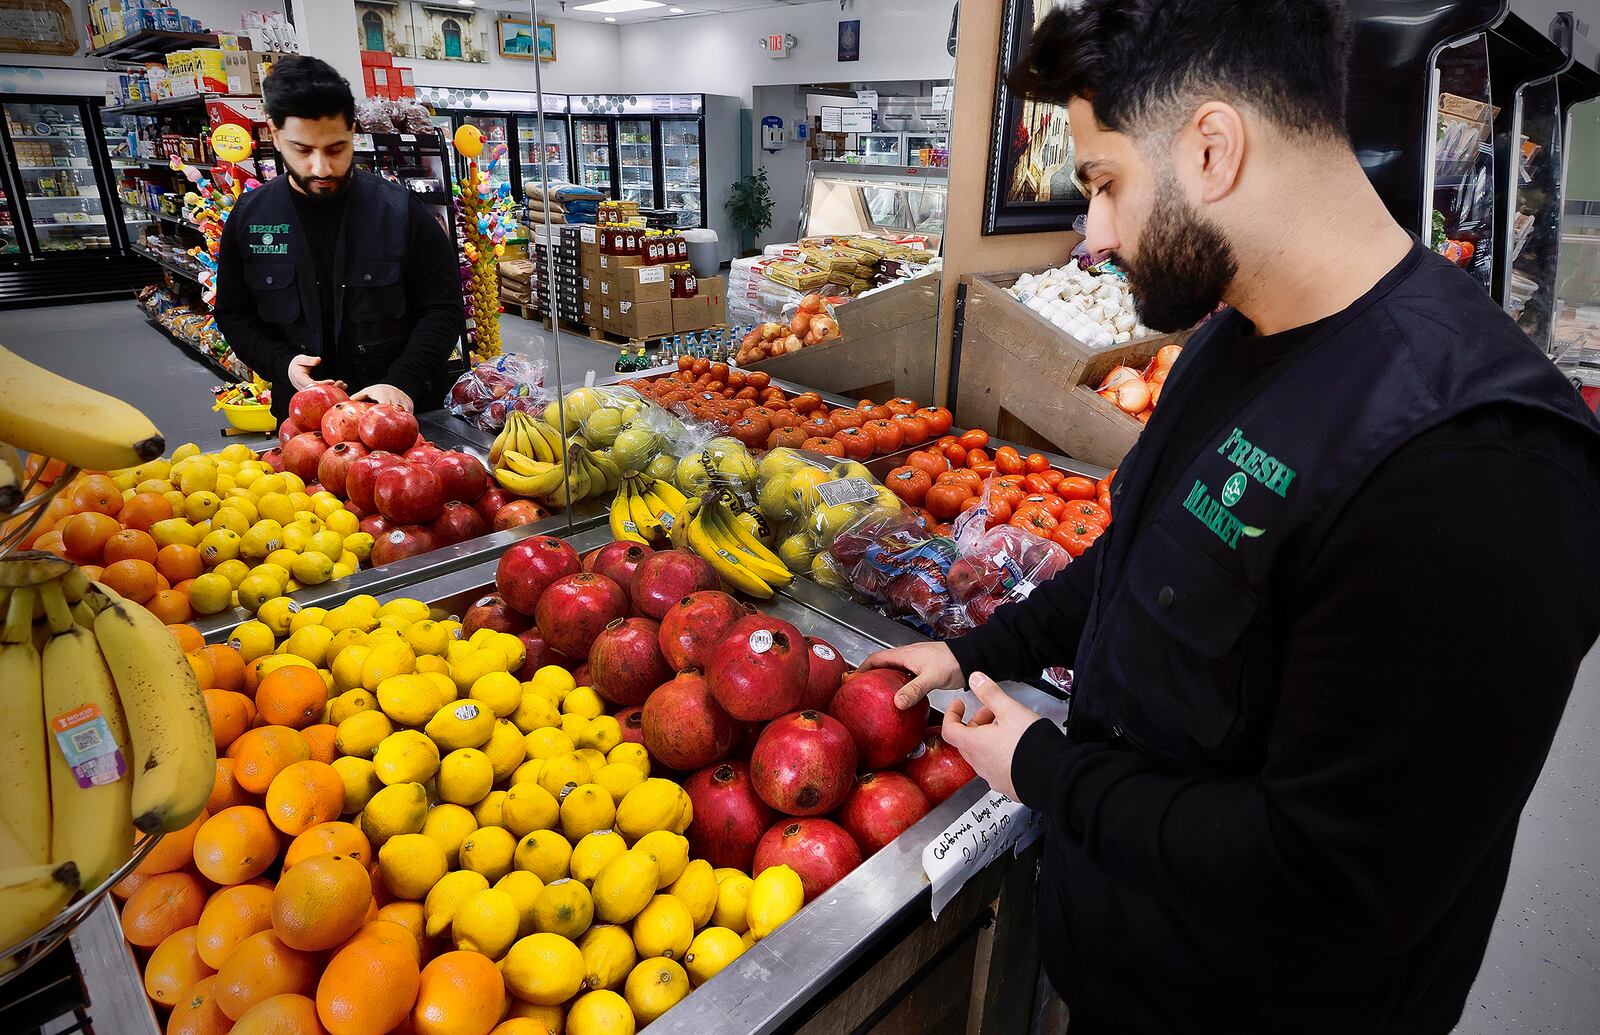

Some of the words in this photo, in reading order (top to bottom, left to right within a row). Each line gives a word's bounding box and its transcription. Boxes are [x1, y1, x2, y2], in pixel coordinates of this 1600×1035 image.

[1216, 427, 1297, 499] FRESH
[1182, 479, 1246, 550] MARKET
[934, 822, 972, 860] California
